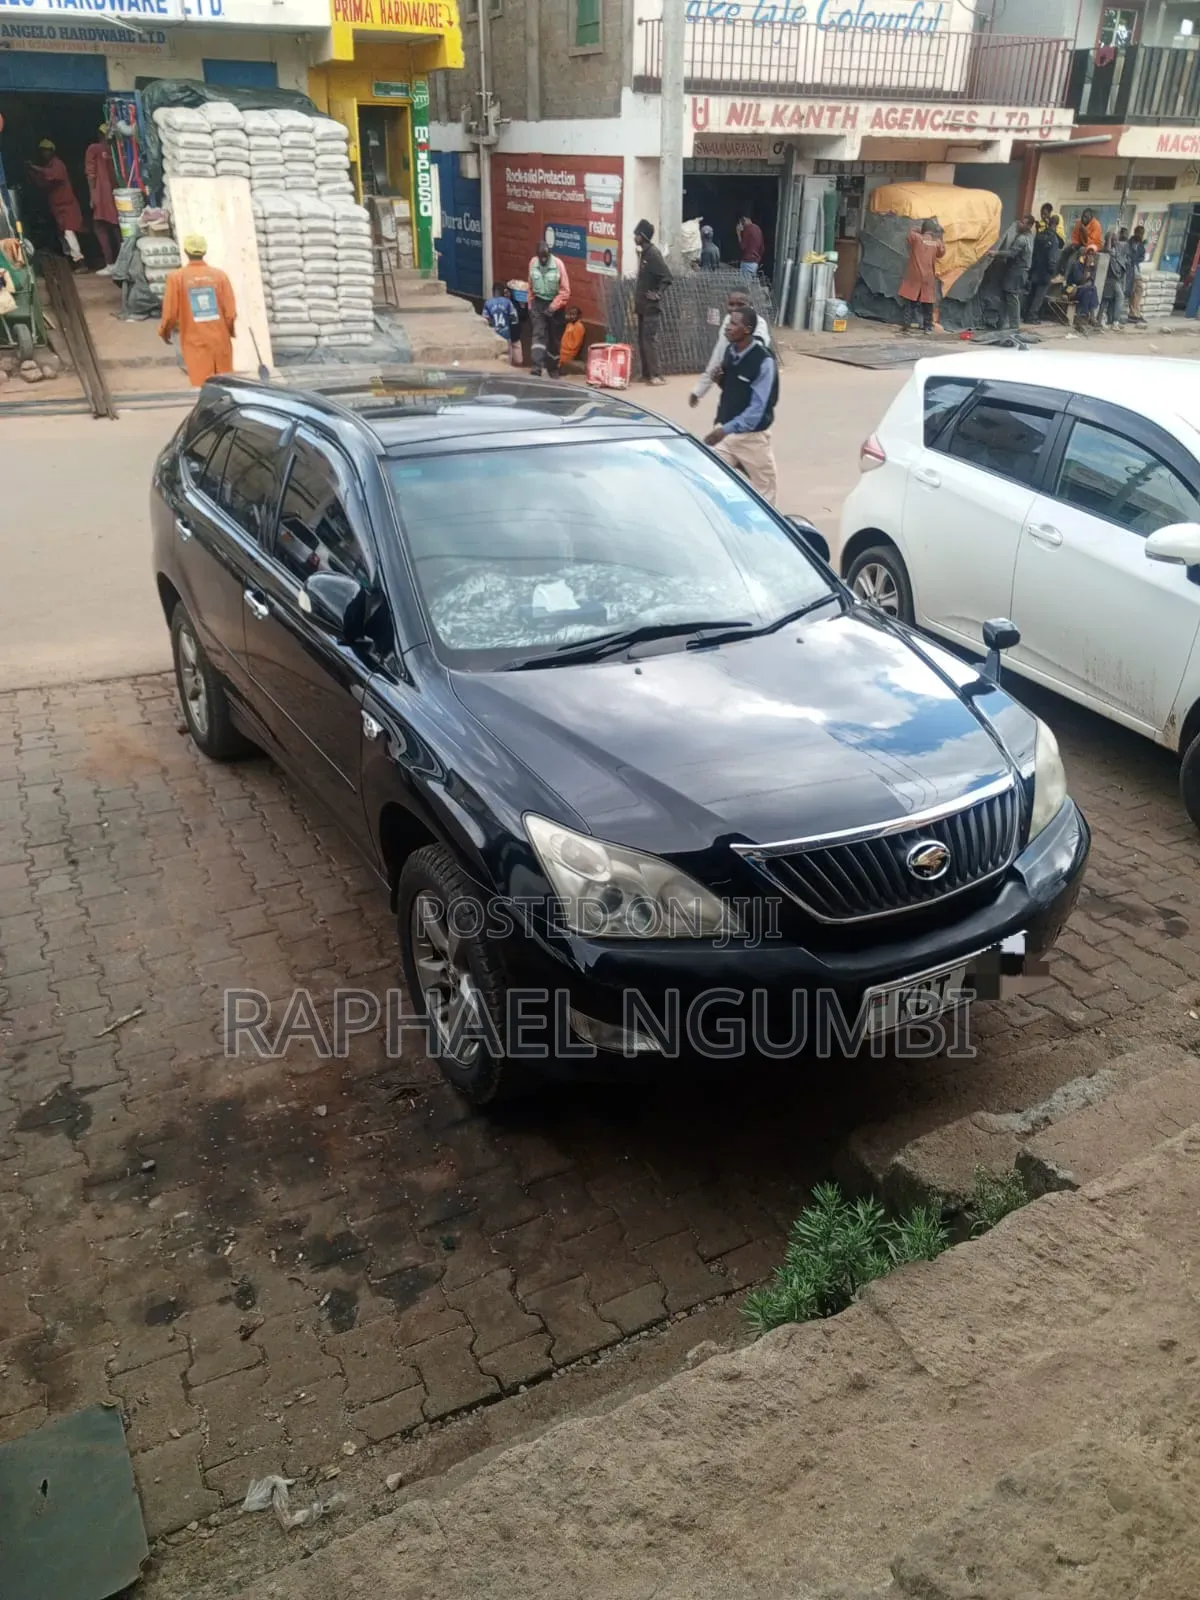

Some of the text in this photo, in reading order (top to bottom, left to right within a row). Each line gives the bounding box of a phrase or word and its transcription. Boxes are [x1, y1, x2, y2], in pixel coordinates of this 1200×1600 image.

[333, 0, 444, 28] PRIMA HARDWARE
[686, 0, 742, 24] ake
[1, 24, 58, 39] ANGELO
[59, 26, 136, 43] HARDWARE
[869, 107, 979, 134] AGENCIES
[538, 168, 576, 186] Protection
[463, 211, 481, 233] Coa
[493, 313, 506, 327] 14
